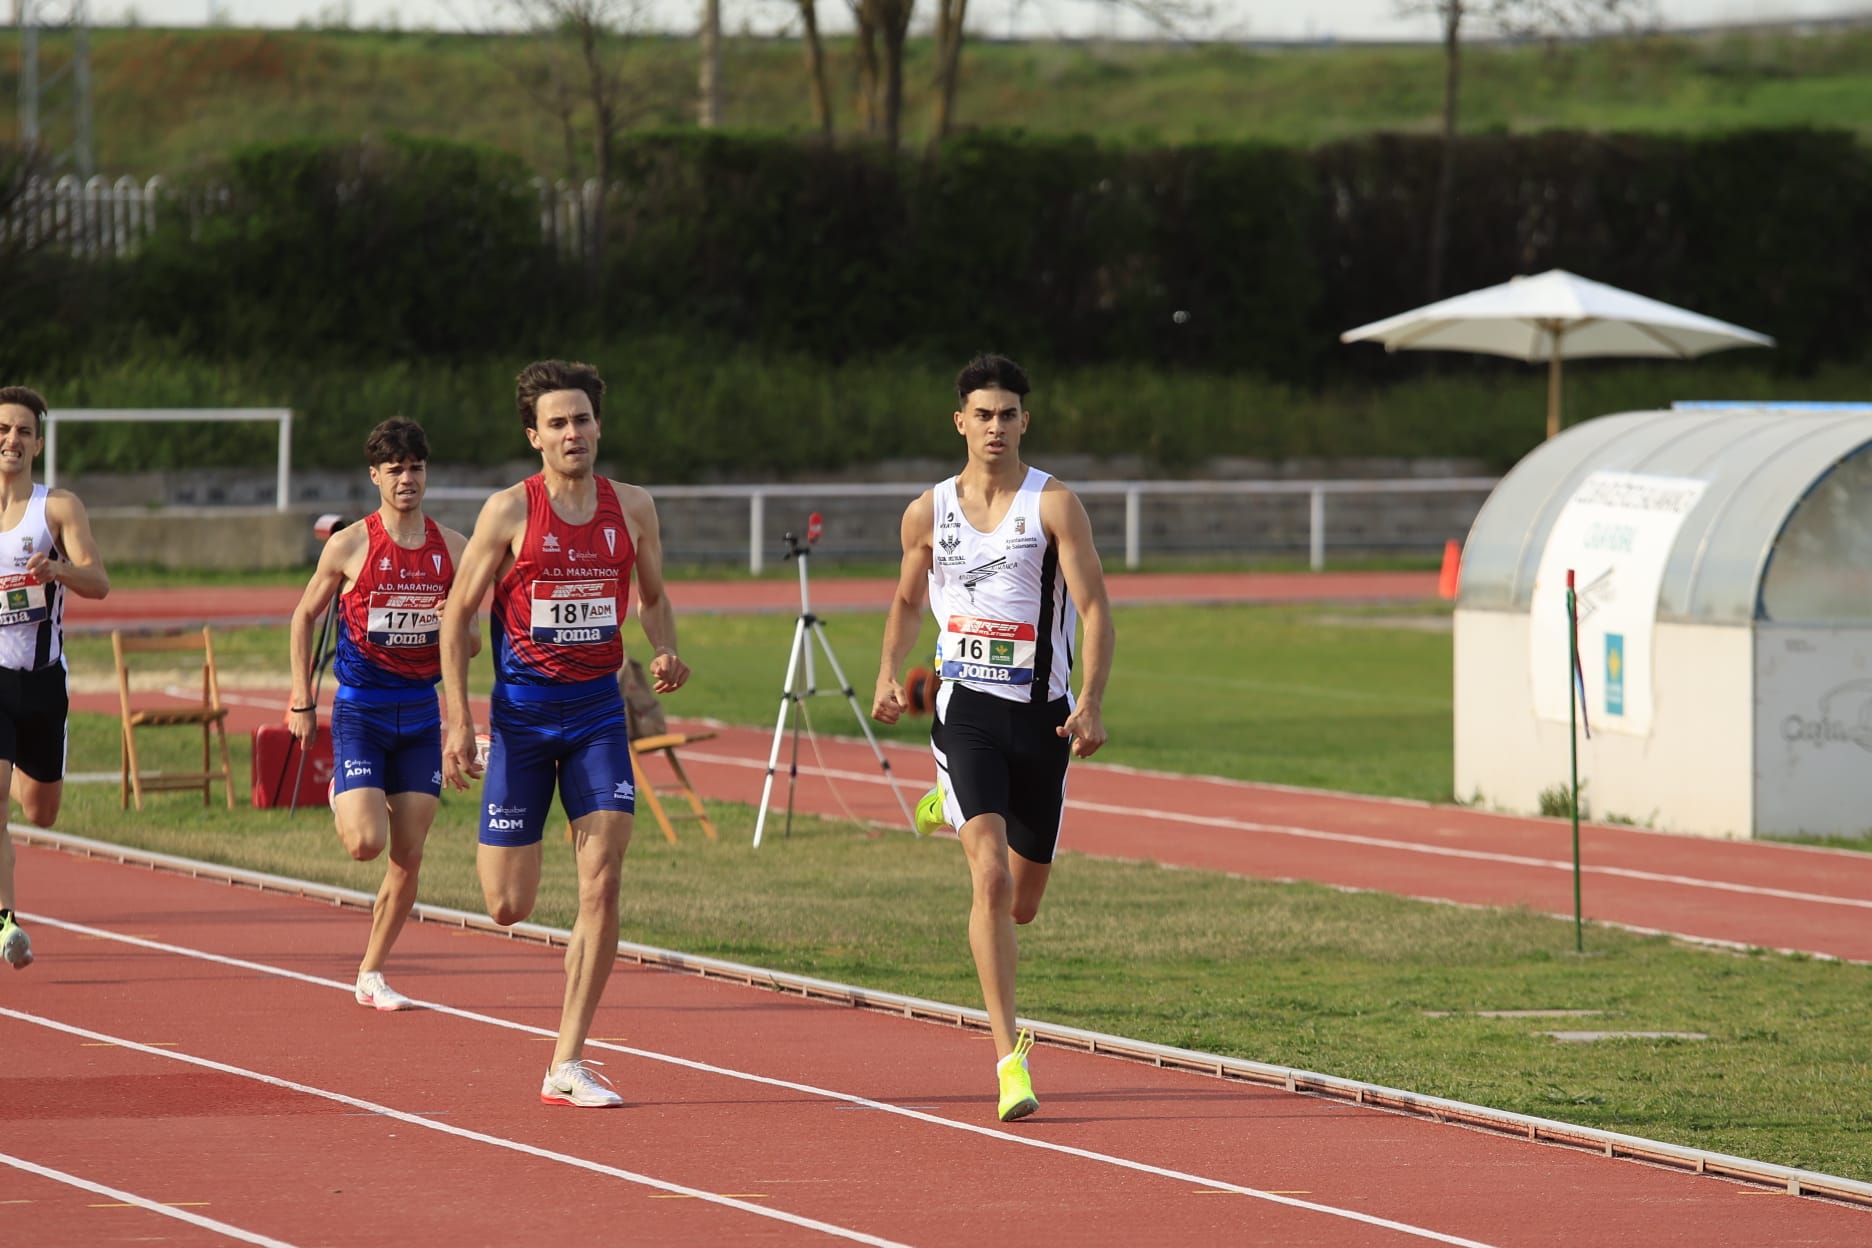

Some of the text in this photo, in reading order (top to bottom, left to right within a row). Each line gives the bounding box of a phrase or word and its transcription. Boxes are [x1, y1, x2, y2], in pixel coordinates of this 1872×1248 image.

[566, 568, 619, 577] MARATHON
[384, 612, 409, 629] 17
[550, 603, 612, 624] 18 ADM
[957, 638, 983, 659] 16
[346, 767, 372, 778] ADM
[488, 818, 524, 830] ADM
